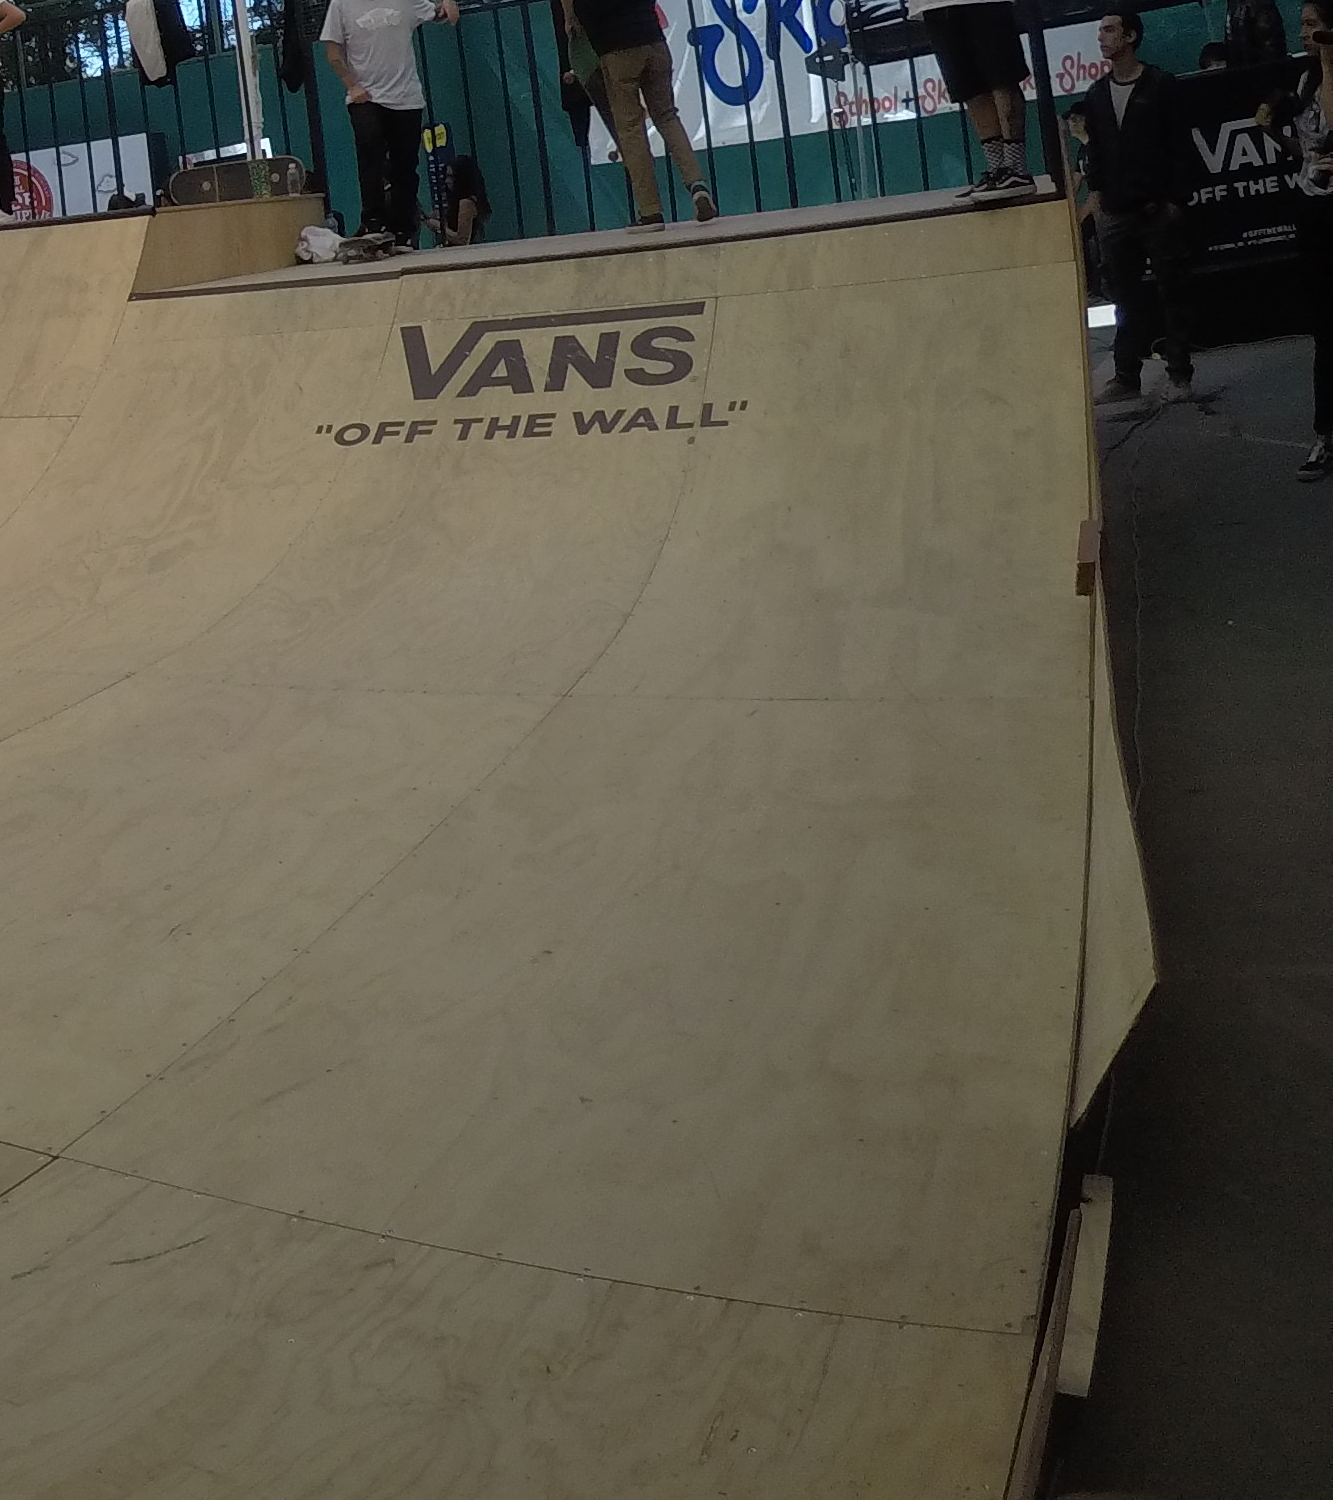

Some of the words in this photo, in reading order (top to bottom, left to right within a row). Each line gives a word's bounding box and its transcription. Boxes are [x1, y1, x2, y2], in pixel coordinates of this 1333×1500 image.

[1190, 116, 1294, 174] VAN
[1233, 175, 1280, 198] THE
[399, 301, 707, 401] VANS
[315, 419, 438, 447] "OFF
[452, 412, 558, 442] THE
[571, 400, 749, 437] WALL"
